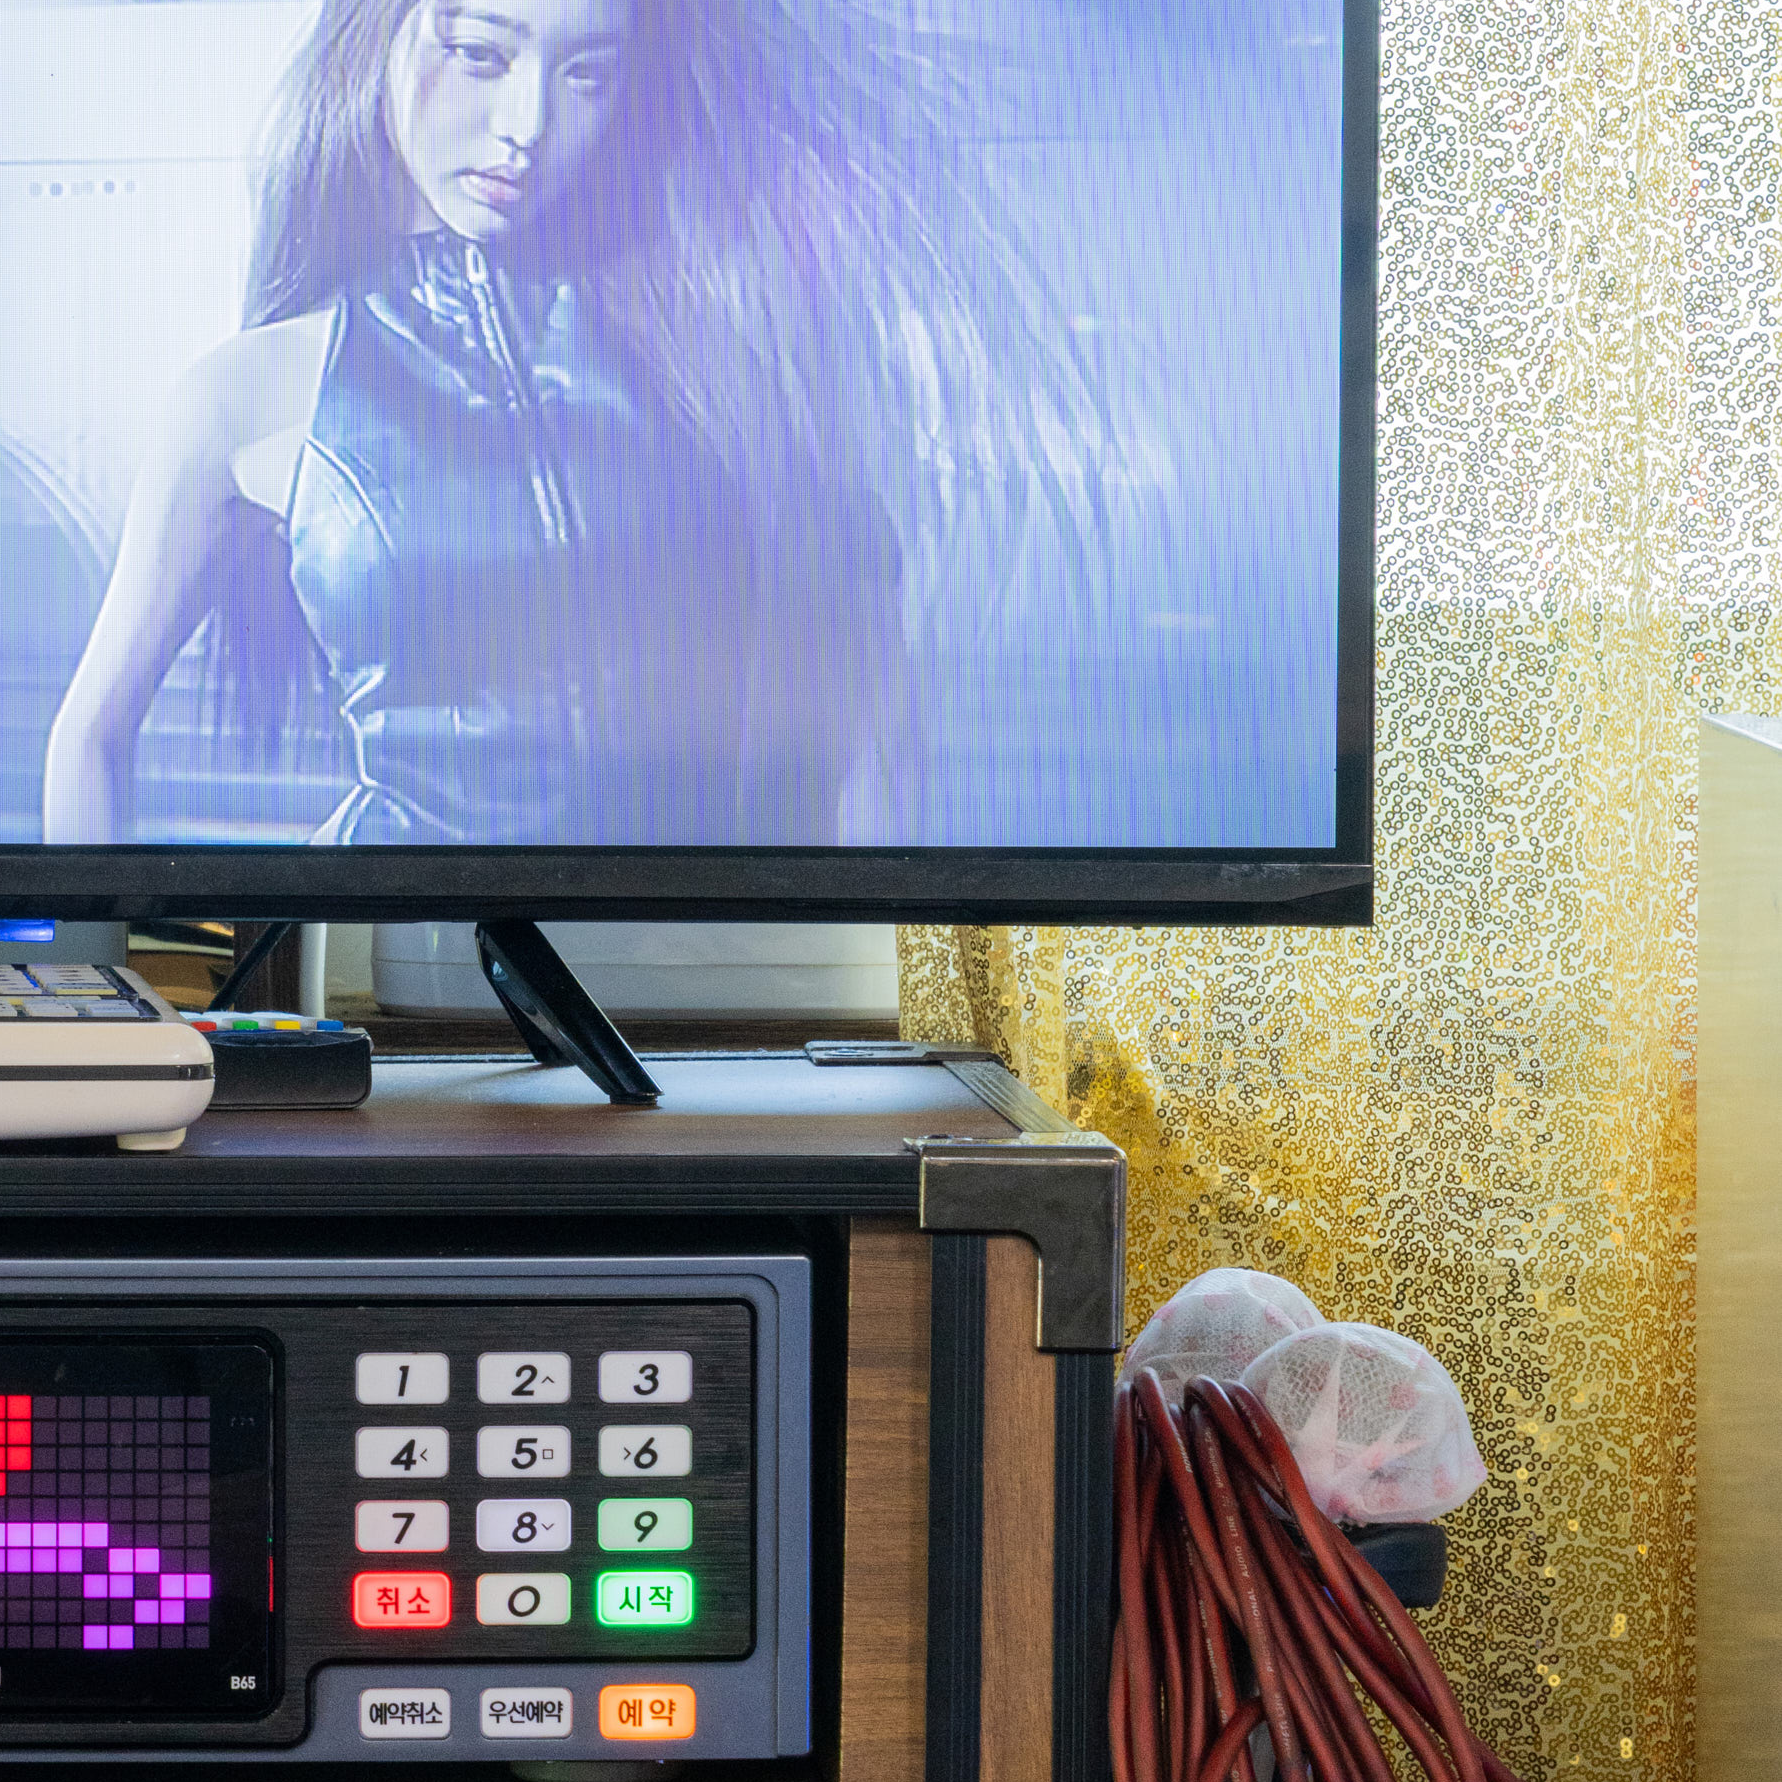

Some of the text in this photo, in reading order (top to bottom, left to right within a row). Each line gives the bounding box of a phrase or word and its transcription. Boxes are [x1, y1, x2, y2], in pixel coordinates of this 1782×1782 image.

[398, 1364, 410, 1397] 1
[510, 1364, 538, 1397] 2
[633, 1363, 660, 1396] 3
[390, 1438, 418, 1471] 4
[510, 1438, 538, 1470] 5
[633, 1437, 658, 1469] 6
[391, 1512, 415, 1544] 7
[511, 1511, 537, 1544] 8
[633, 1510, 658, 1543] 9
[377, 1586, 431, 1615] 취소
[618, 1585, 673, 1613] 시작
[230, 1676, 256, 1689] B65
[369, 1701, 443, 1726] 예약취소
[488, 1700, 563, 1725] 우선예약
[618, 1698, 676, 1727] 예약
